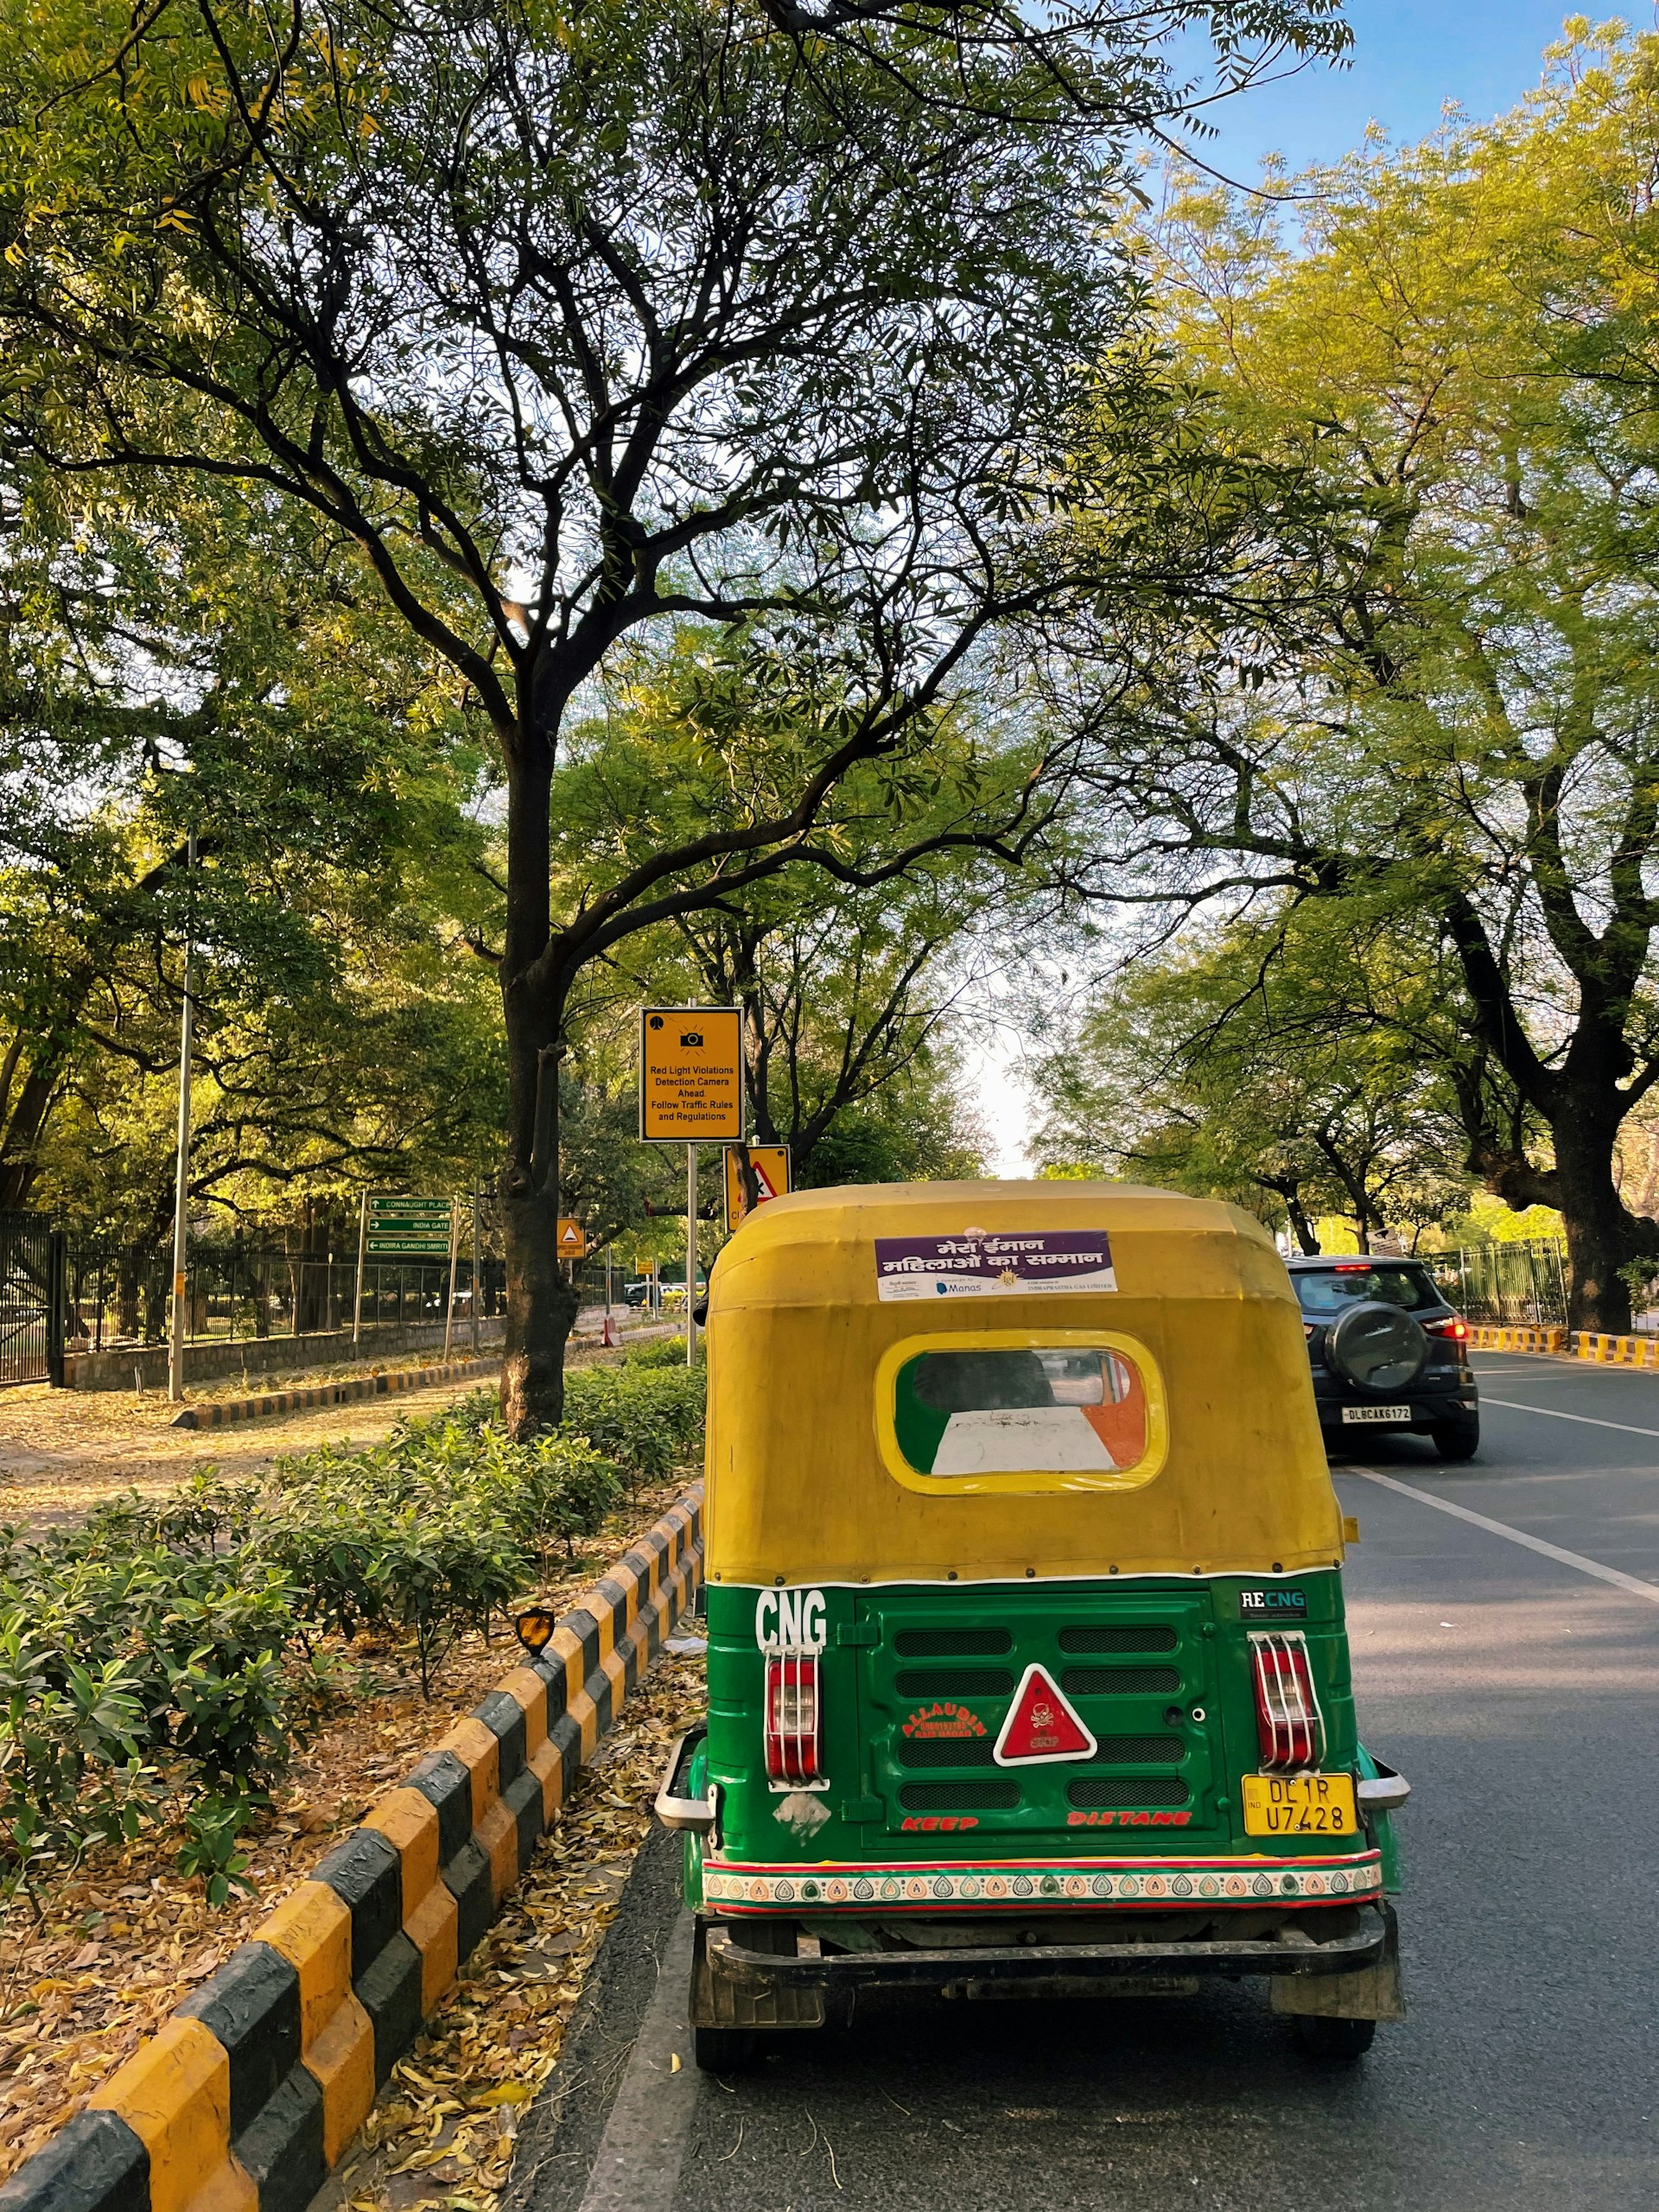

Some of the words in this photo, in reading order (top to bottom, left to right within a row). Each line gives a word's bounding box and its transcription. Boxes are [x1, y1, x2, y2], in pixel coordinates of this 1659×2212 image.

[651, 1065, 667, 1074] Red
[670, 1065, 690, 1076] Light
[693, 1065, 734, 1074] Violations
[656, 1077, 695, 1086] Detection
[697, 1077, 729, 1086] Camera
[658, 1112, 674, 1121] and
[677, 1112, 726, 1122] Regulations
[937, 1240, 977, 1255] मेरा
[982, 1237, 1045, 1253] ईमान
[882, 1253, 982, 1273] महिलाओं
[987, 1255, 1019, 1267] का
[1025, 1252, 1103, 1266] सम्मान
[949, 1284, 982, 1293] Manas
[755, 1589, 826, 1650] CNG
[901, 1816, 979, 1831] KEEP
[1066, 1811, 1192, 1826] DISTANE
